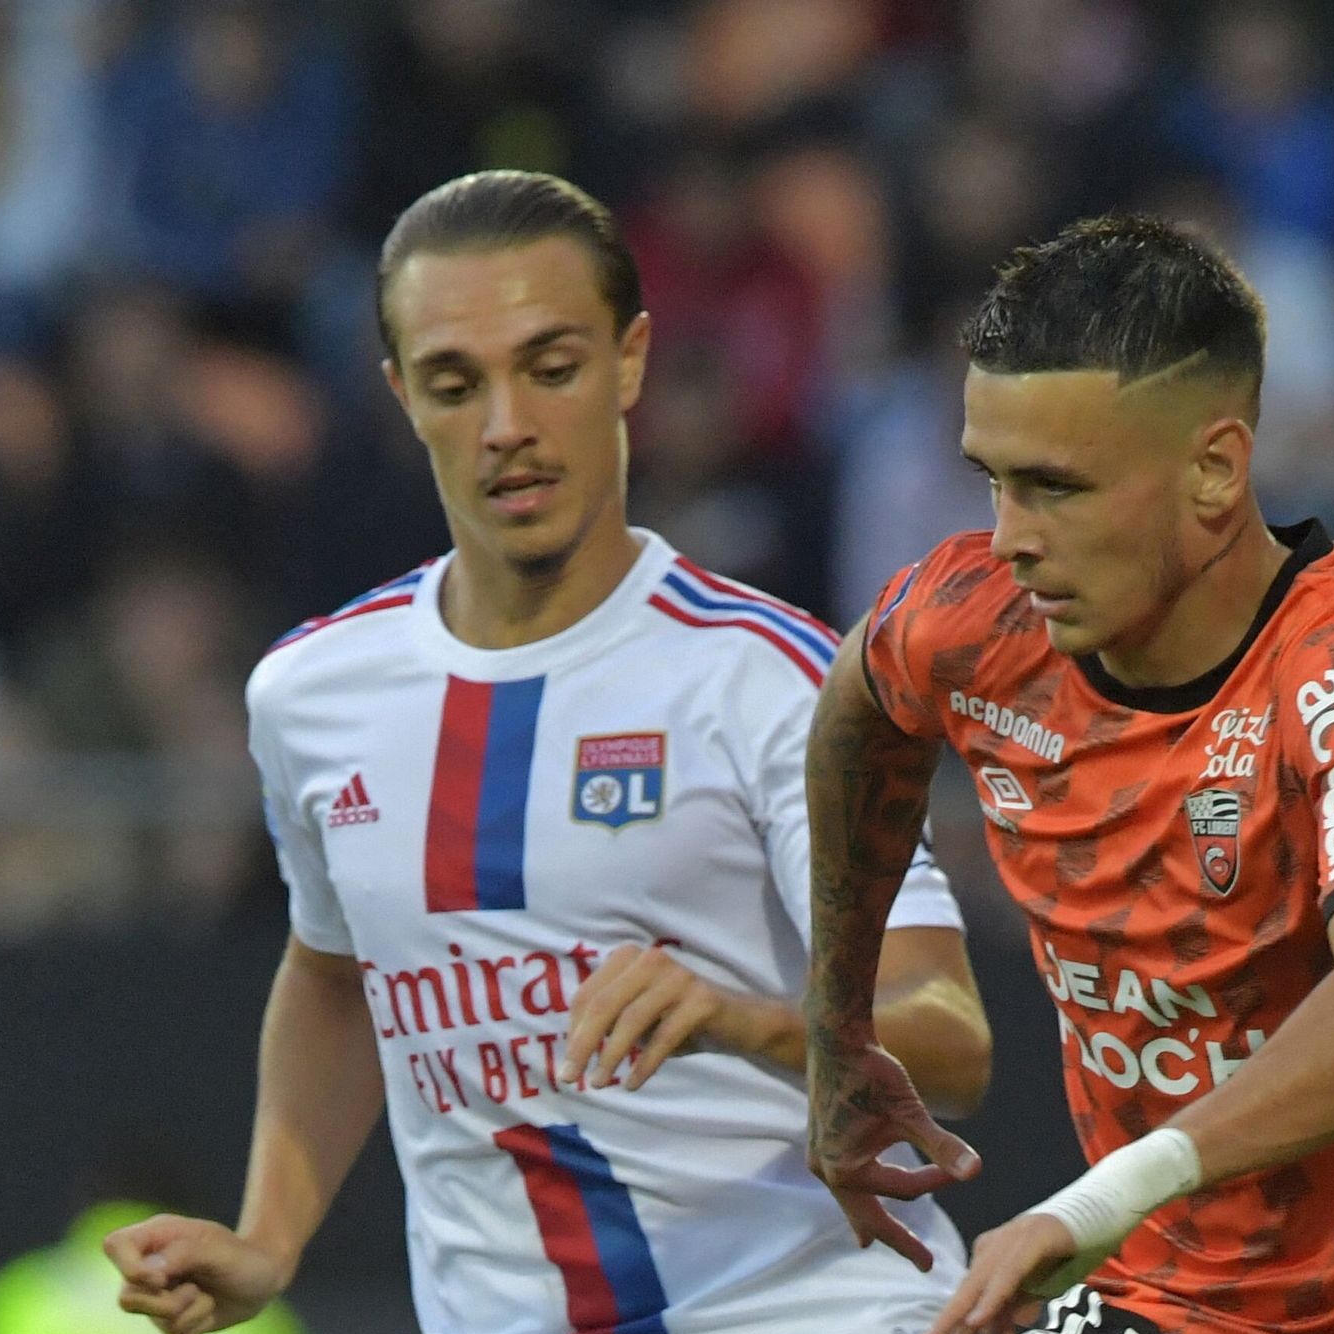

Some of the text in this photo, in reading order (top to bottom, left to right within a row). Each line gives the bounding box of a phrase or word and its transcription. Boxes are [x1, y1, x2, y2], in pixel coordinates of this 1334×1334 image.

[950, 690, 1065, 764] ACADOMIA
[328, 807, 379, 828] adidas
[580, 773, 656, 815] OL
[1044, 940, 1217, 1028] JEAN
[409, 1047, 469, 1114] FLY
